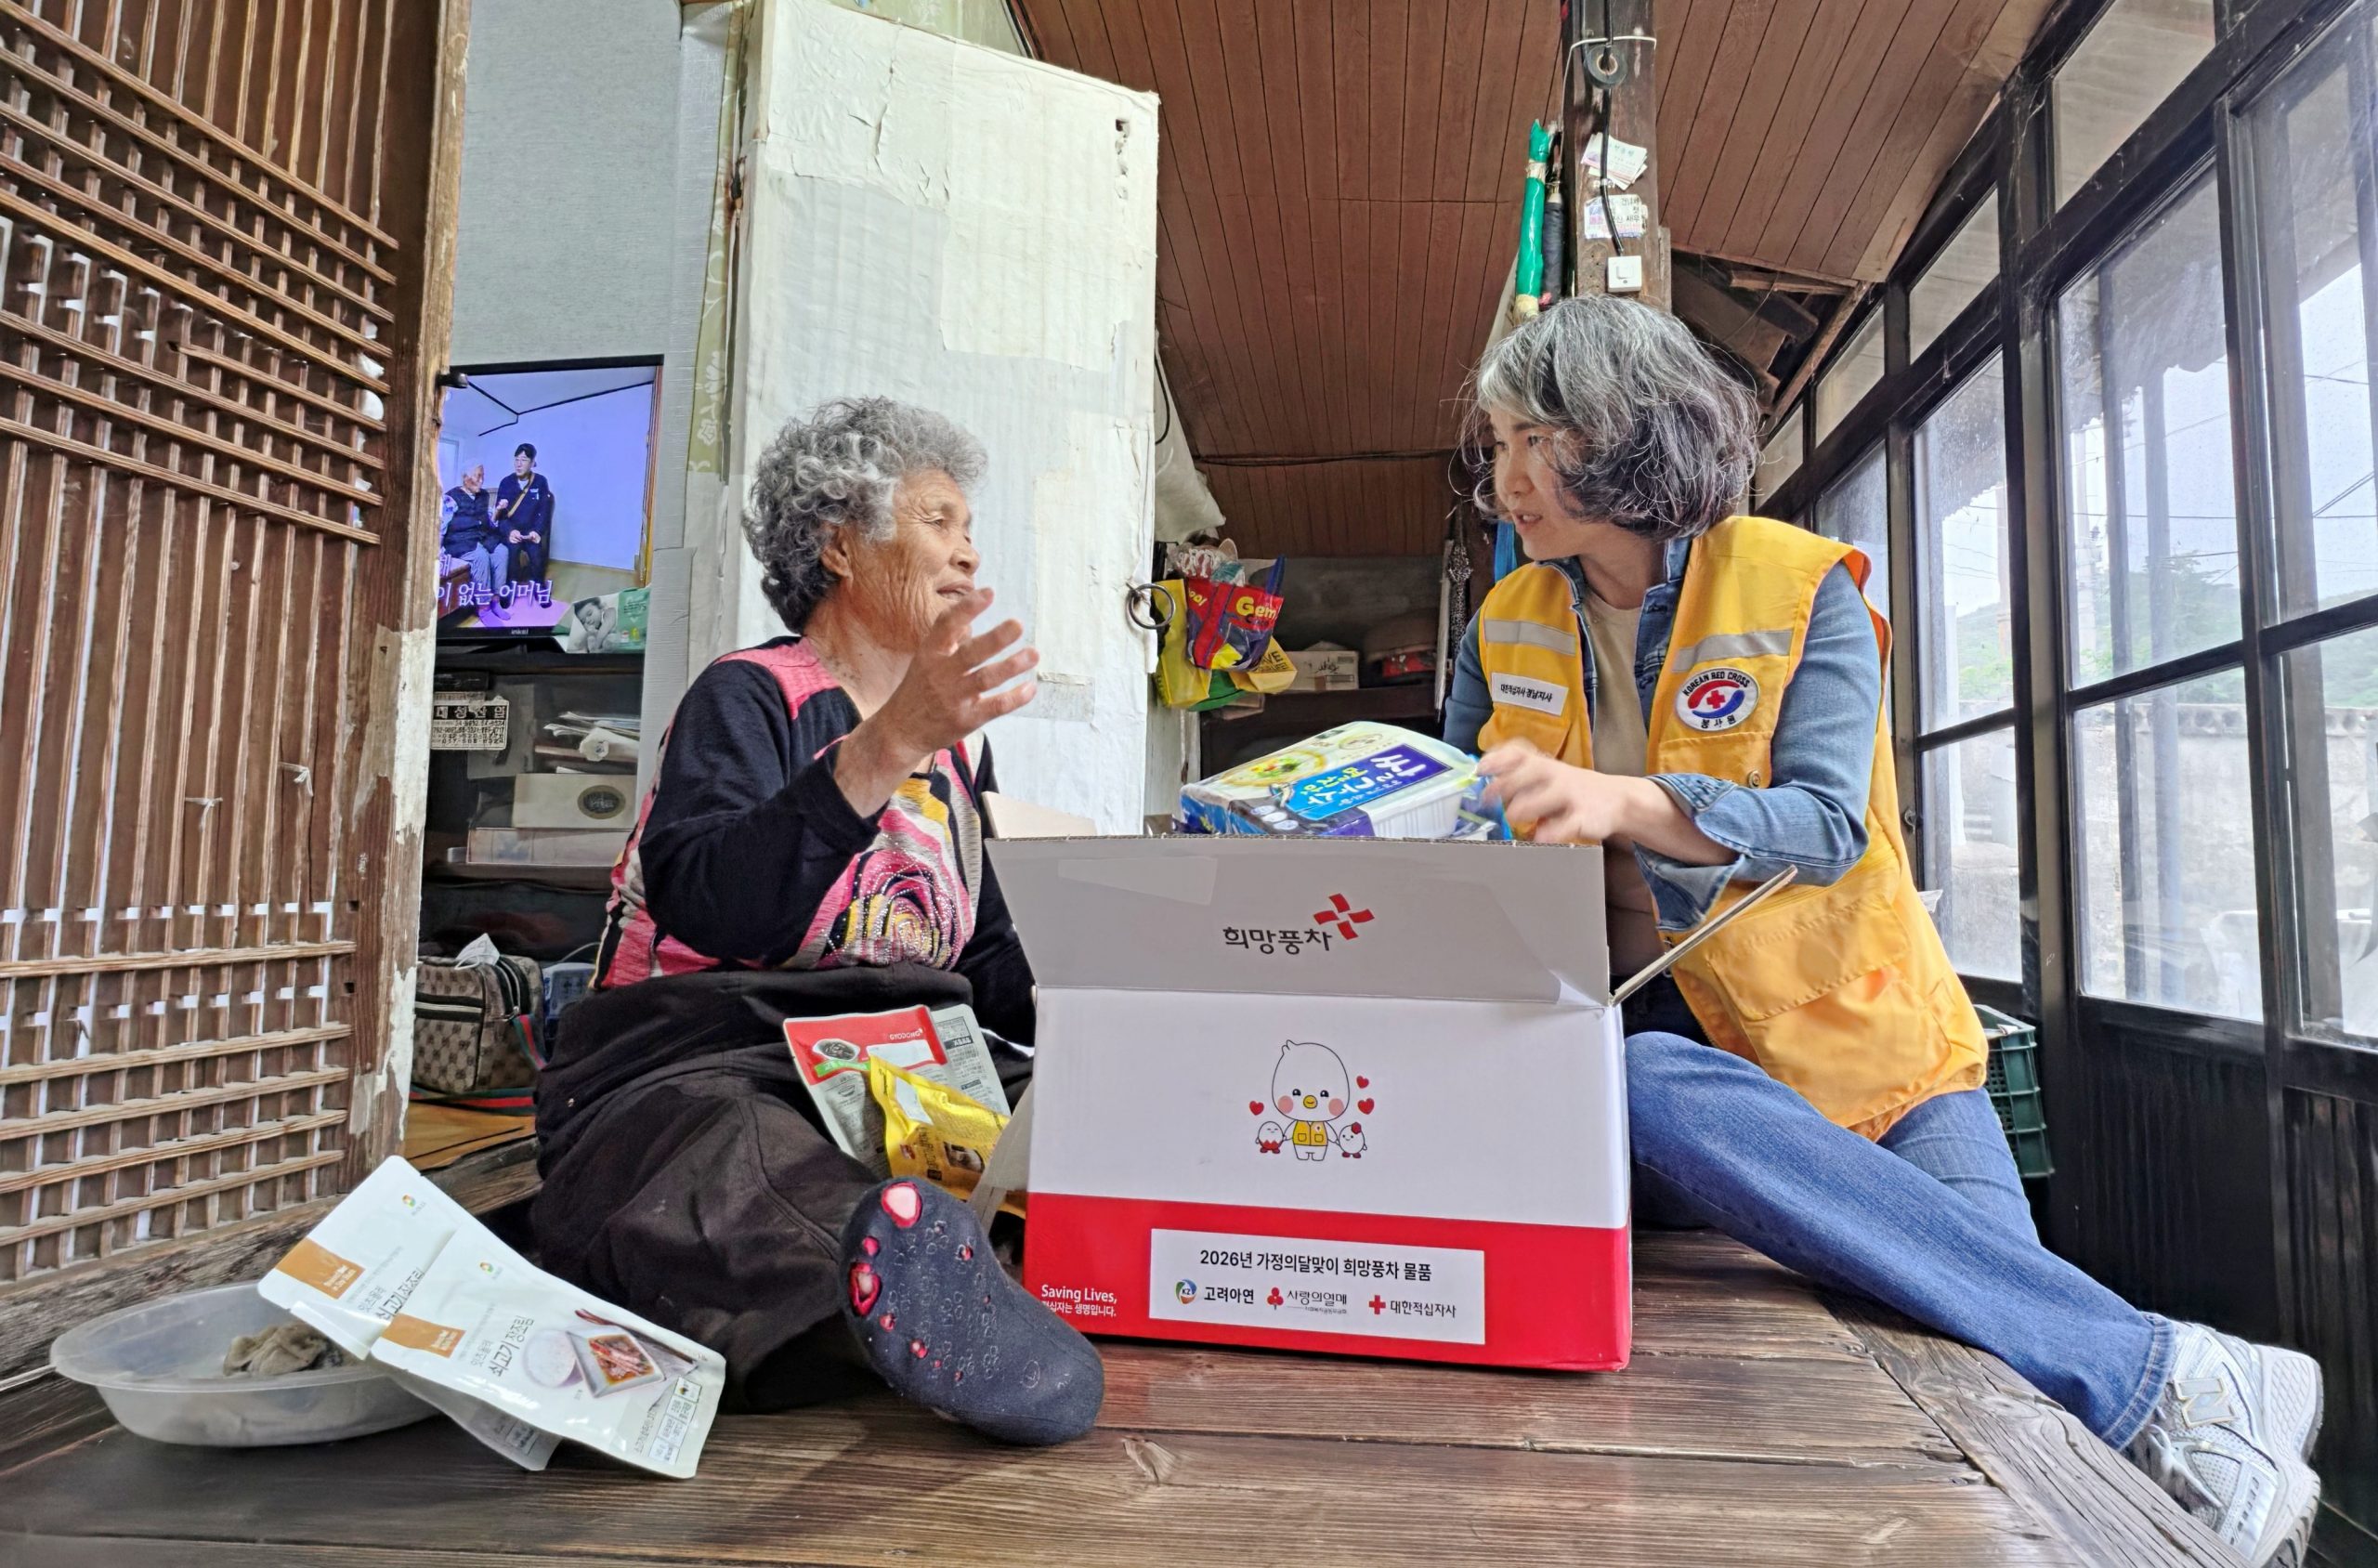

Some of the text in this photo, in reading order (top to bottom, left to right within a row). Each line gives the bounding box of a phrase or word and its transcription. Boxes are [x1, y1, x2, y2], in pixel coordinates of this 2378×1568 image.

[459, 581, 493, 606] 없는
[500, 580, 553, 606] 어머님
[1235, 596, 1277, 619] Gem
[1682, 674, 1709, 696] KOREAN
[1728, 672, 1750, 687] CROSS
[1222, 926, 1332, 955] 희망풍차
[1199, 1249, 1432, 1282] 2026년 가정의달맞이 희망풍차 물품
[1041, 1284, 1117, 1304] Saving Lives,
[1203, 1287, 1254, 1304] 고려아연
[1287, 1290, 1347, 1306] 사랑의열매
[1075, 1302, 1117, 1317] 생명입니다.
[1390, 1300, 1457, 1318] 대한적십자사
